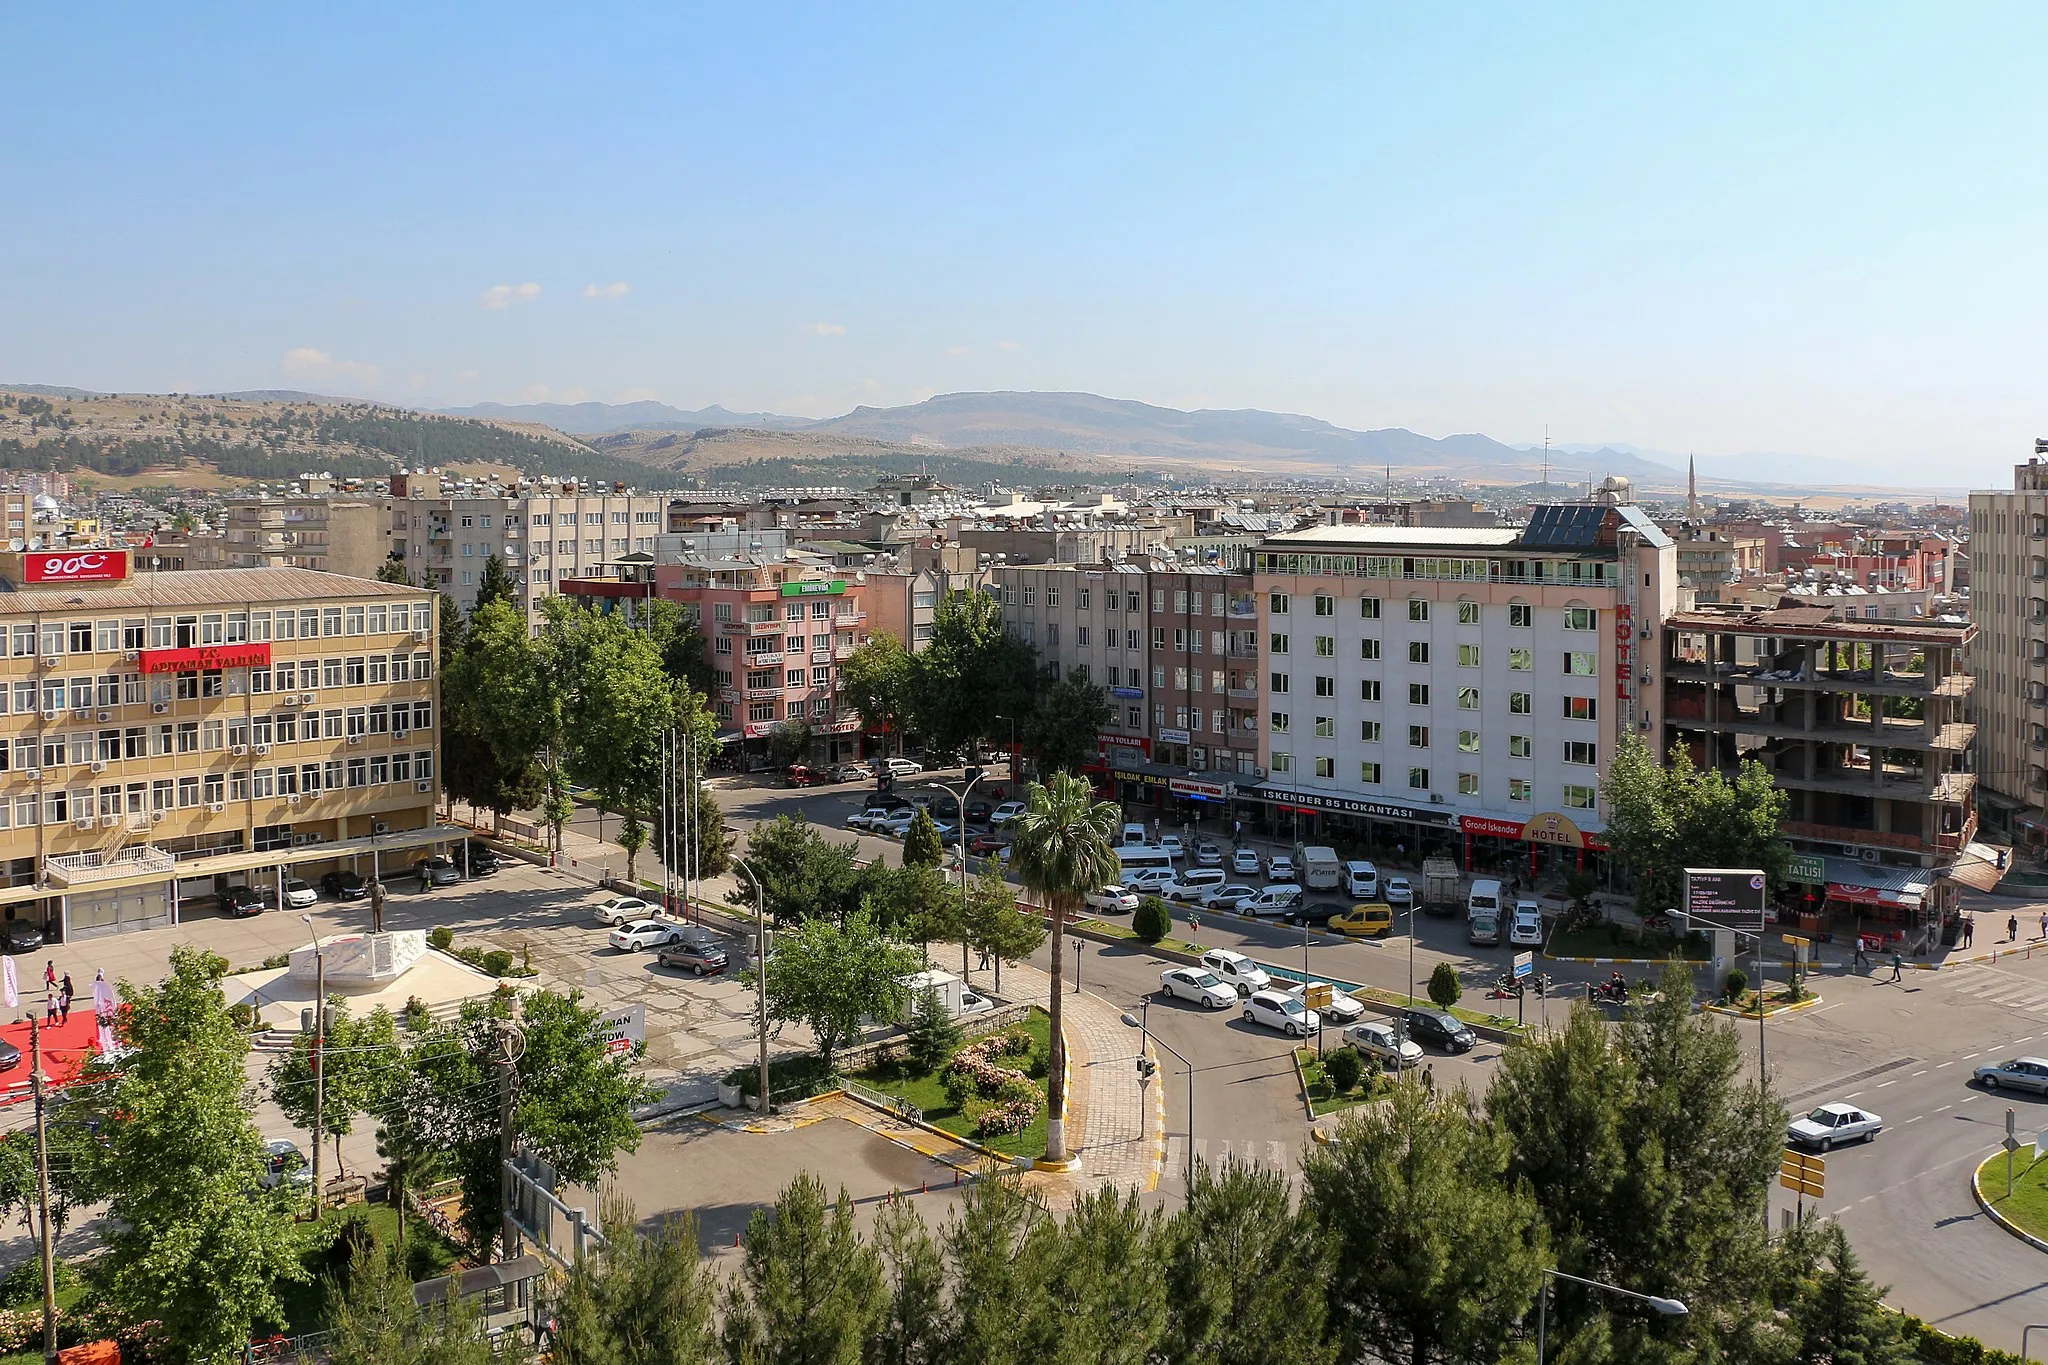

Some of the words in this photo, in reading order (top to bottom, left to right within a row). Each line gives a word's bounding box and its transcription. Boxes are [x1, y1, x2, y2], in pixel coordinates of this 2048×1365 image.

[1616, 604, 1631, 699] HOTEL
[152, 658, 215, 673] ADIYAMAN
[829, 722, 855, 732] NOTER
[1098, 734, 1115, 743] HAVA
[1115, 736, 1141, 746] YOLLARI
[1143, 775, 1167, 785] EMLAK
[1263, 790, 1321, 805] İSKENDER
[1325, 800, 1340, 808] 85
[1344, 801, 1413, 818] LOKANTASI
[1465, 819, 1487, 831] Grand
[1488, 821, 1518, 835] İskender
[1531, 829, 1572, 844] HOTEL
[1788, 864, 1822, 878] TATLISI
